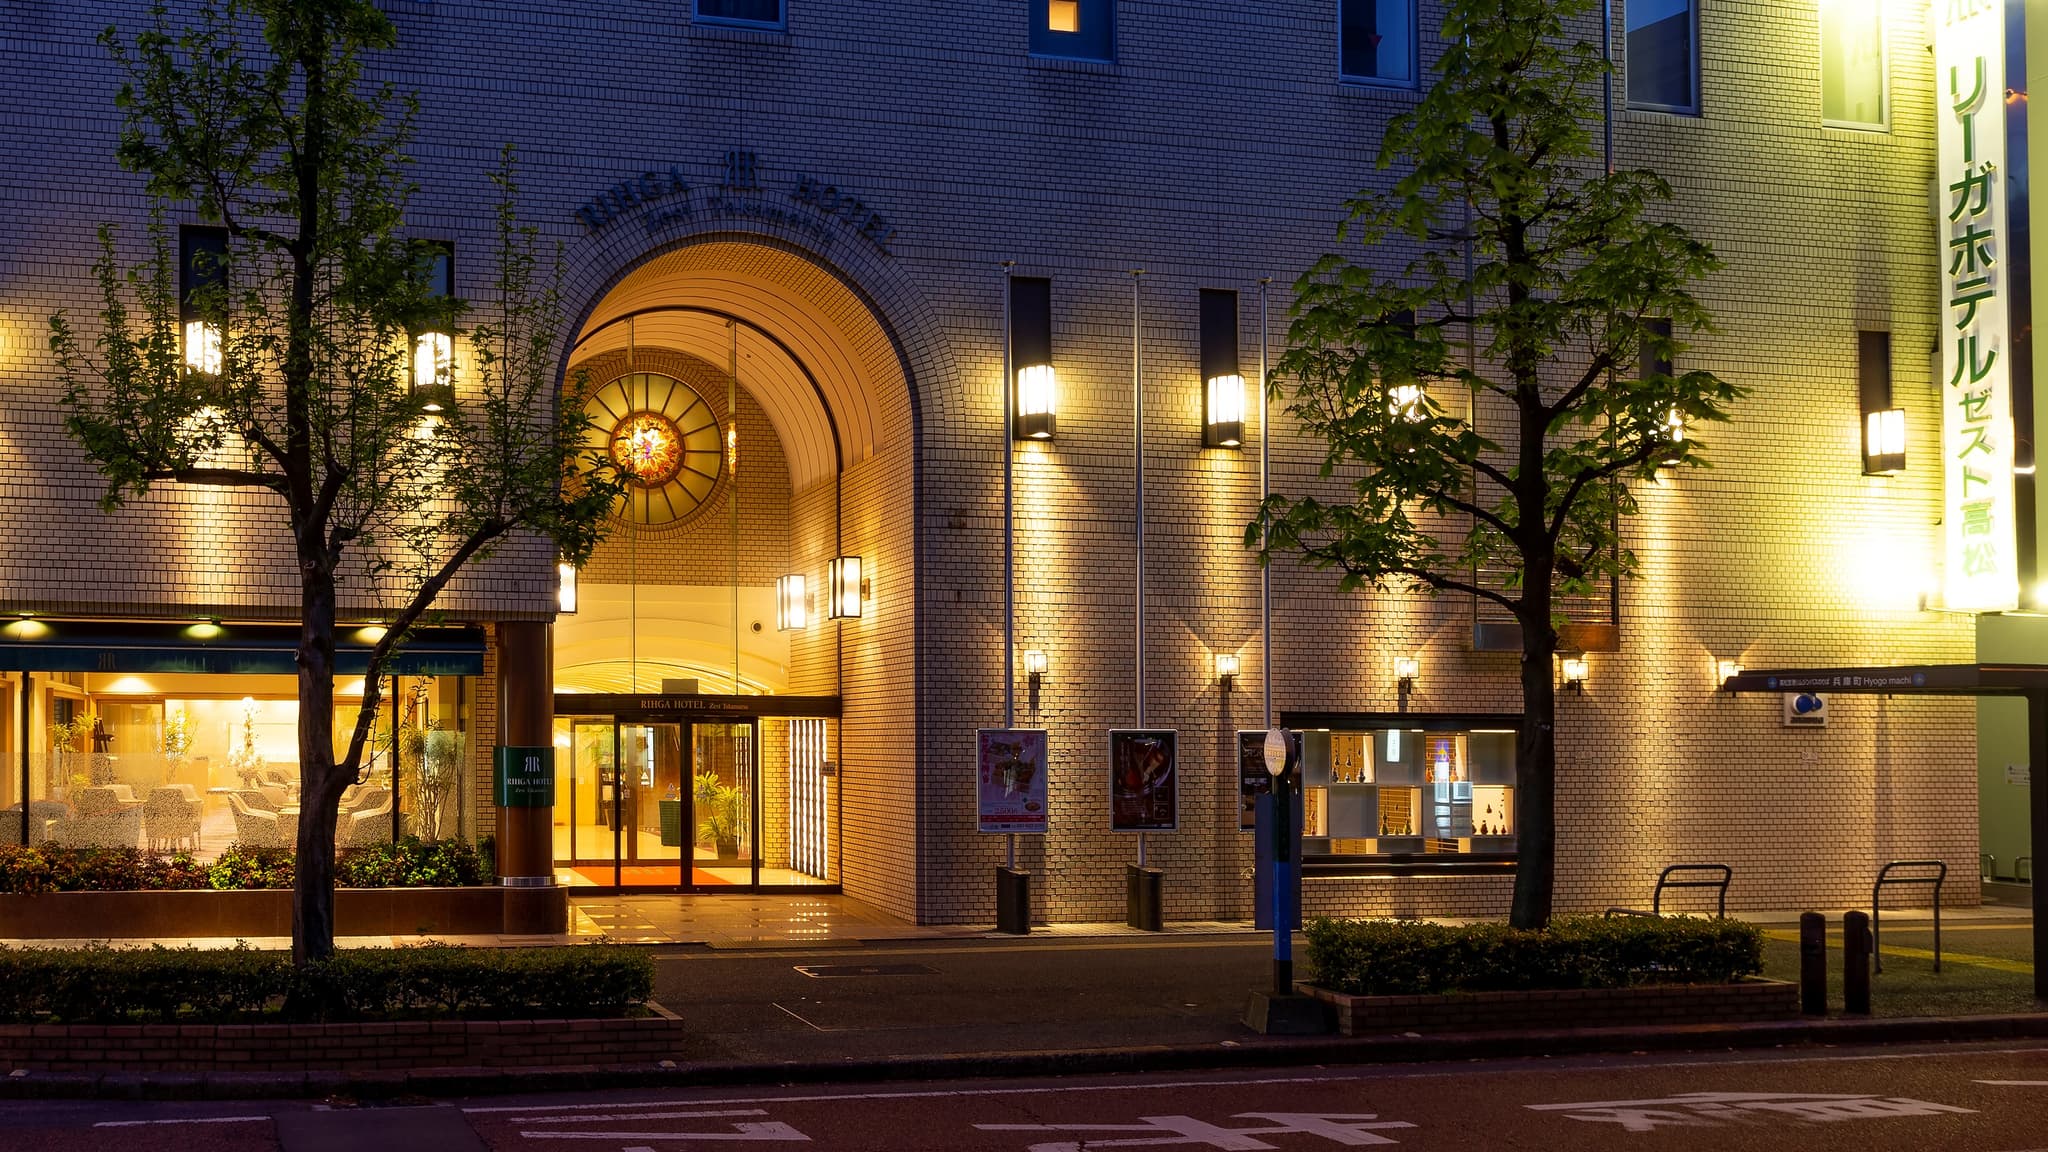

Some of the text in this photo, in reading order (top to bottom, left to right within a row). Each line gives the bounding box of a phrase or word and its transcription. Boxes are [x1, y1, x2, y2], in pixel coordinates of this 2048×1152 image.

[575, 165, 897, 247] RIHGA HOTEL
[643, 204, 694, 235] Zest
[1948, 56, 1997, 578] リーガホテルゼスト高松
[1863, 676, 1888, 688] Hyogo
[1888, 675, 1912, 685] machi
[640, 699, 671, 710] RIHGA
[674, 699, 706, 710] HOTEL
[507, 777, 531, 785] RIHGA
